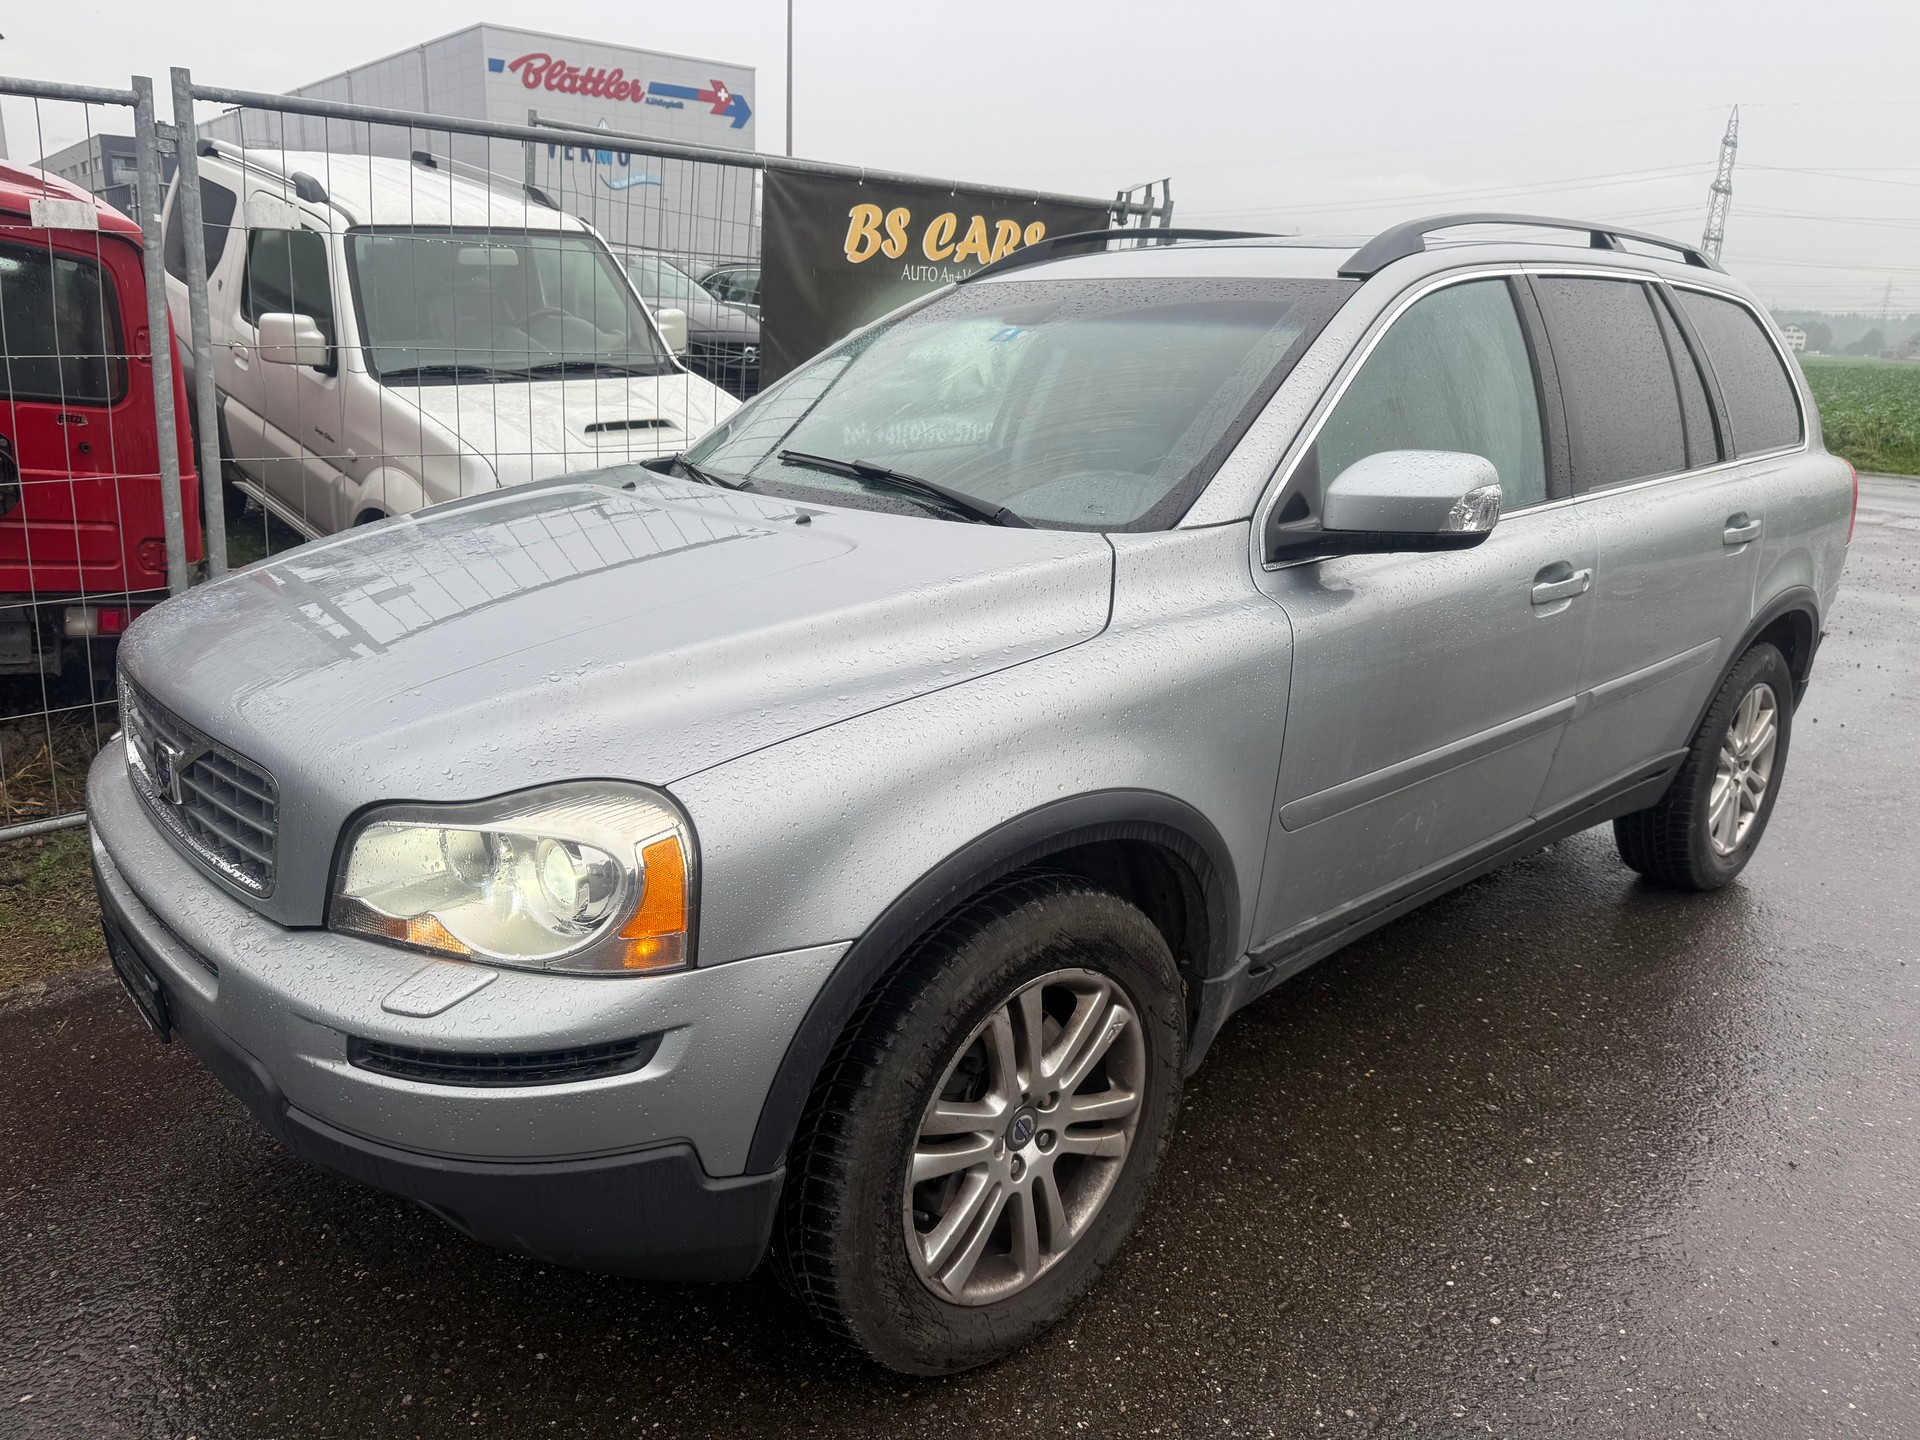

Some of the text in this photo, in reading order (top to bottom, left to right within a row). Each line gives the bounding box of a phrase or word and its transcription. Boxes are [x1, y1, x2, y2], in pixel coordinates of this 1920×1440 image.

[508, 53, 645, 103] Blättler
[844, 204, 911, 263] BS
[900, 263, 938, 282] AUTO
